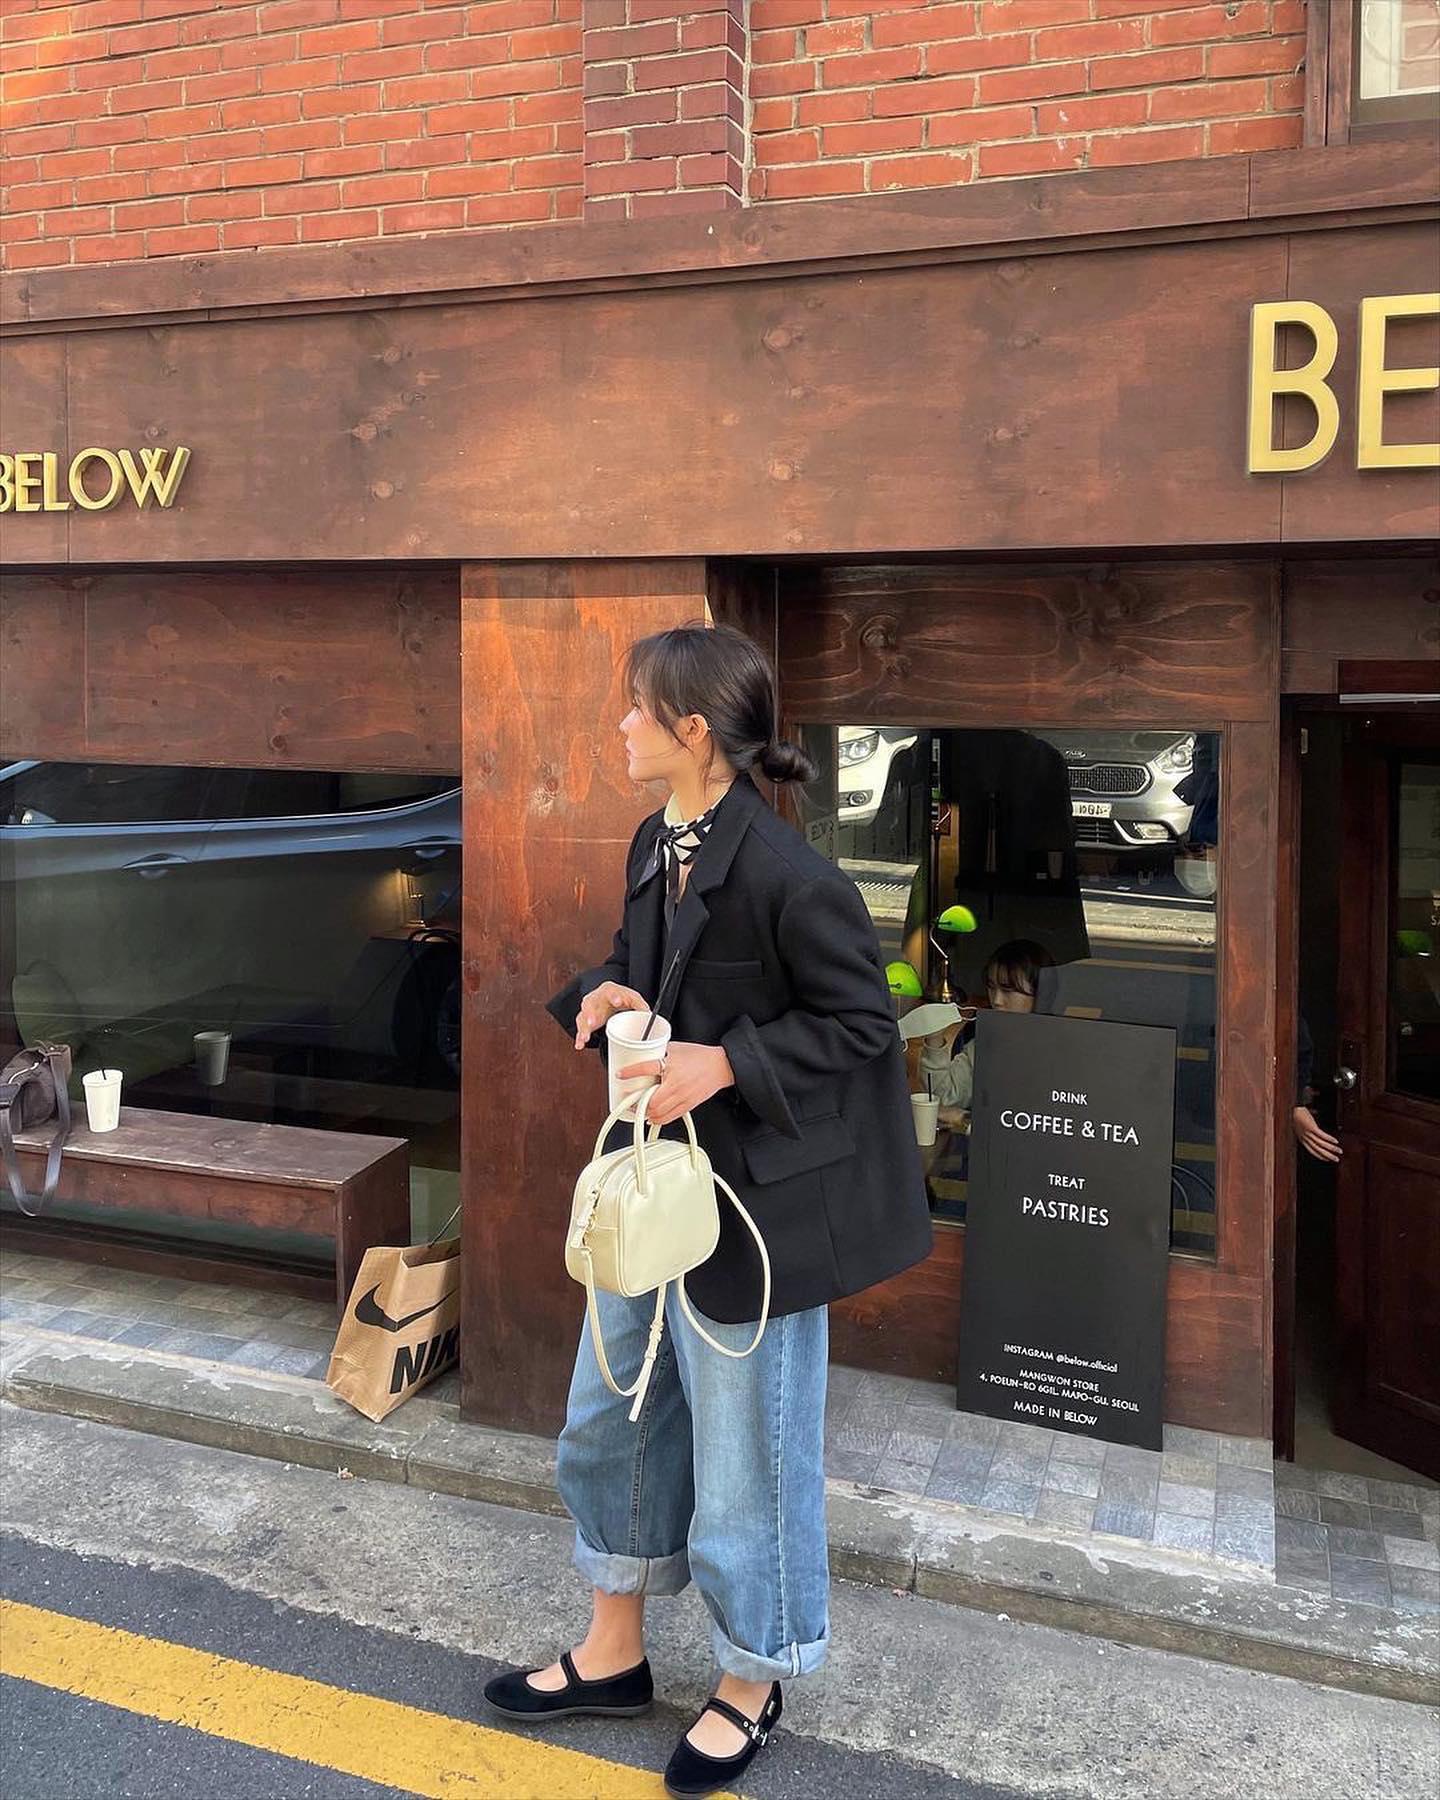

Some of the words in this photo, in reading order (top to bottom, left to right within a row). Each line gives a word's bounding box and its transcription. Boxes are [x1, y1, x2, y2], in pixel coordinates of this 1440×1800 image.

[1248, 293, 1440, 474] BE
[1051, 1090, 1088, 1106] DRINK
[1000, 1110, 1074, 1136] COFFEE
[1081, 1120, 1096, 1139] &
[1101, 1123, 1139, 1146] TEA
[1048, 1174, 1086, 1190] TREAT
[1022, 1197, 1109, 1227] PASTRIES
[1003, 1343, 1054, 1361] INSTAGRAM
[1056, 1352, 1118, 1373] @below.official
[989, 1374, 1036, 1391] POEUN-RO
[1111, 1398, 1140, 1413] SEOUL
[1019, 1369, 1071, 1387] MANGWON
[1072, 1379, 1100, 1393] STORE
[1013, 1400, 1045, 1416] MADE
[1049, 1407, 1061, 1419] IN
[1064, 1411, 1099, 1426] BELOW
